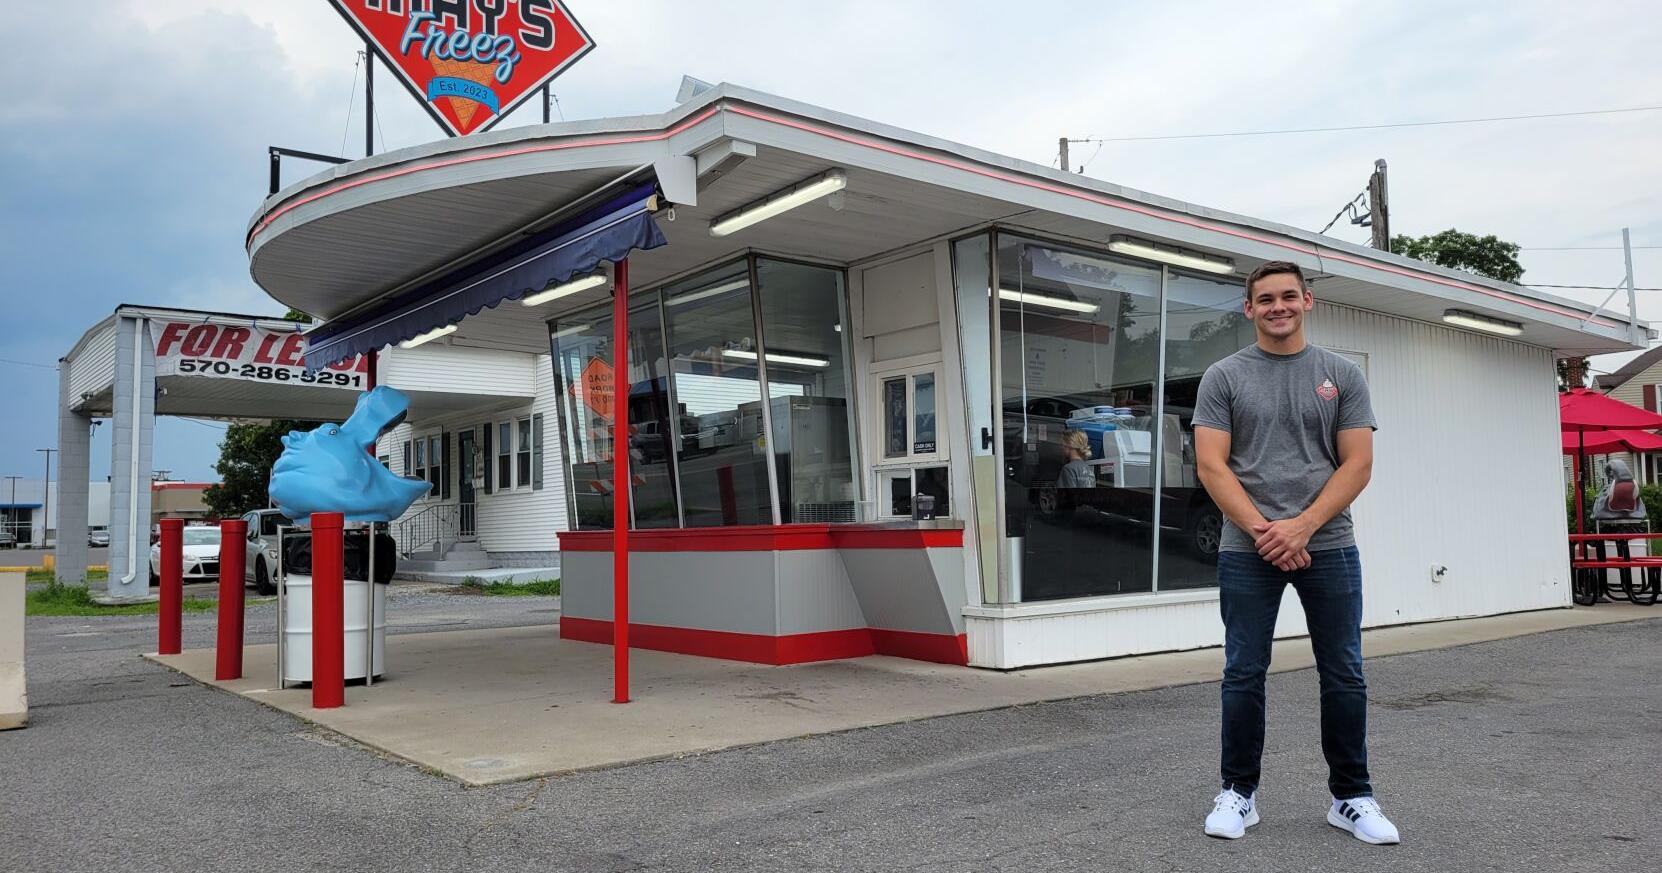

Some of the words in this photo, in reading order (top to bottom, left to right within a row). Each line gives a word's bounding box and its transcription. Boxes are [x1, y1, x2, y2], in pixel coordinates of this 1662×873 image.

[401, 11, 521, 84] Freez
[440, 81, 459, 92] Est.
[463, 84, 488, 99] 2023
[156, 322, 250, 360] FOR
[179, 359, 361, 387] 570-286-5291
